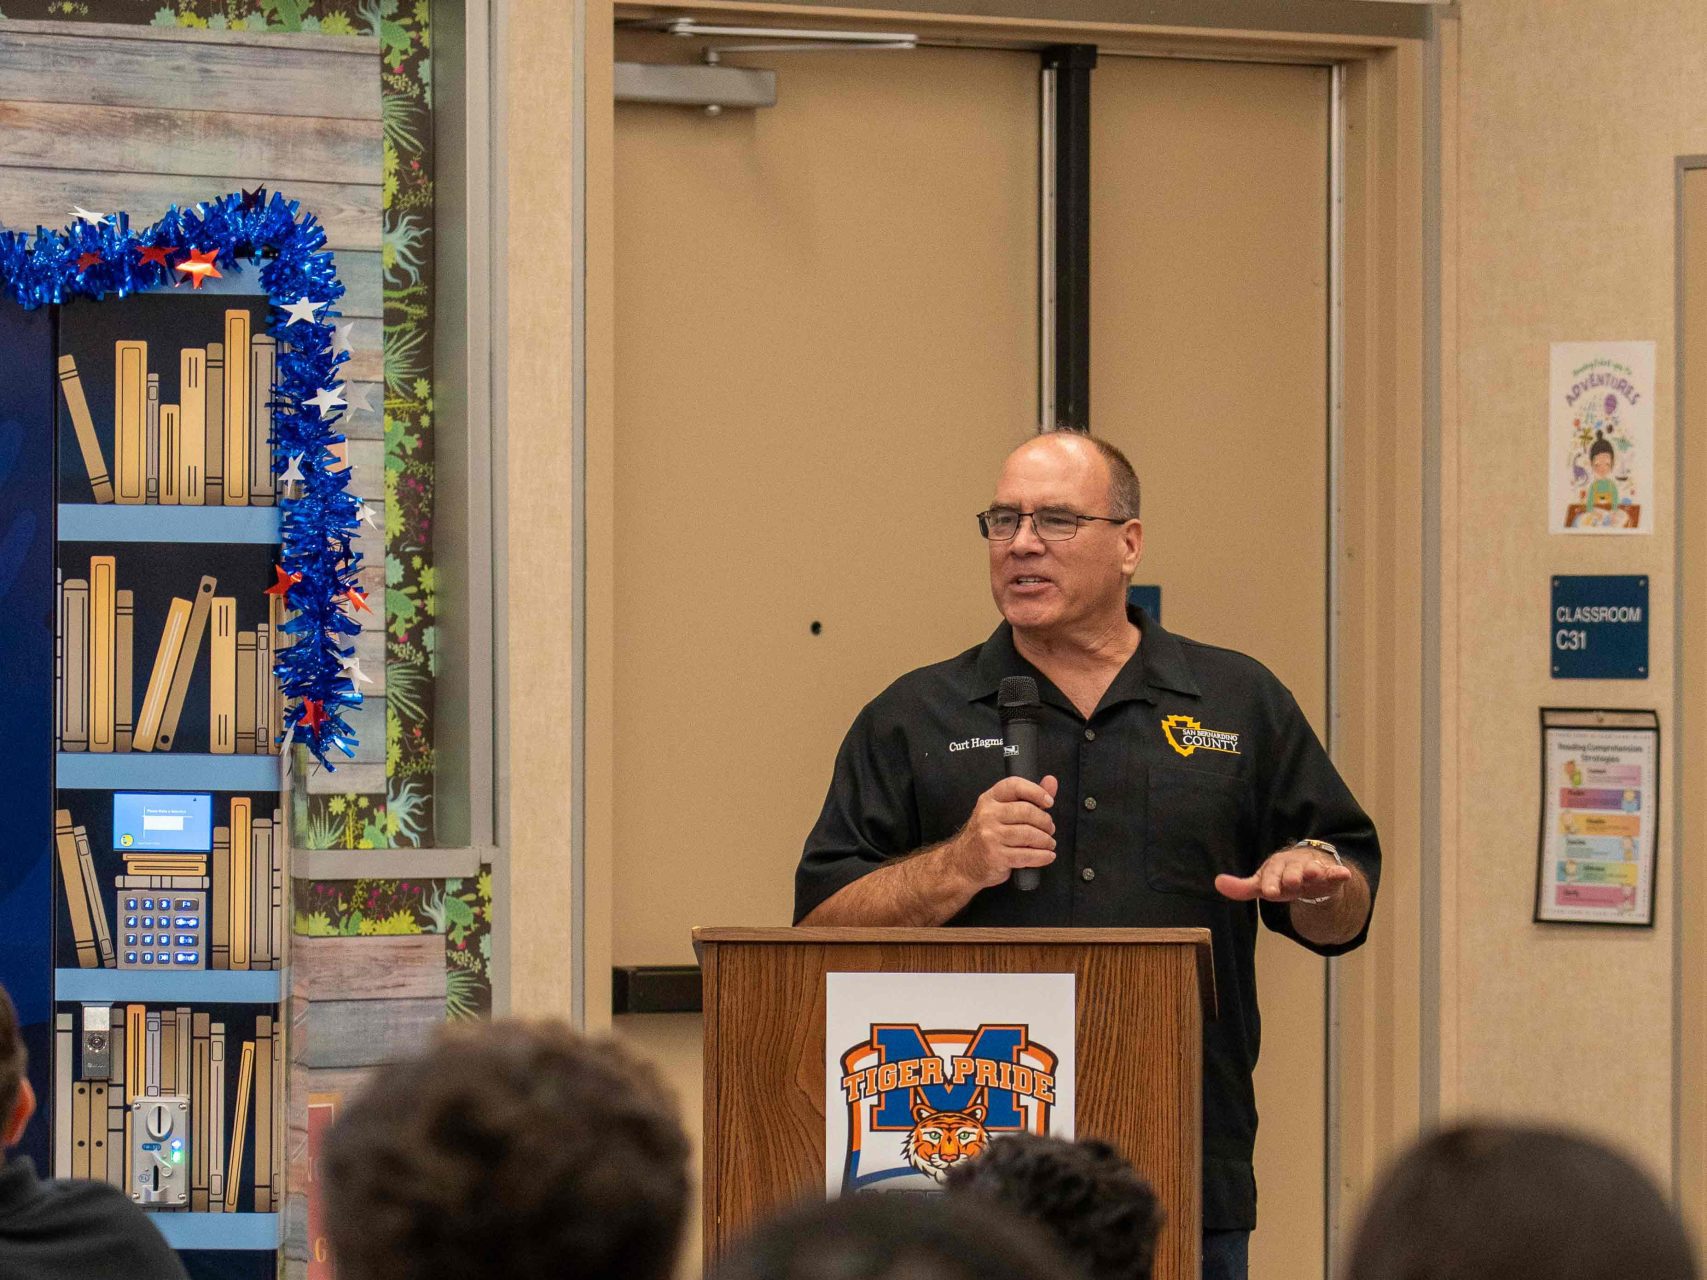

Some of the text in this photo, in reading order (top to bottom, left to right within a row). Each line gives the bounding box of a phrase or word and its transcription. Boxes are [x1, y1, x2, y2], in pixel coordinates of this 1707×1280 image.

[1565, 372, 1641, 408] ADVENTURES
[1556, 606, 1642, 623] CLASSROOM
[1556, 629, 1587, 651] C31
[1182, 728, 1238, 742] SAN BERNARDINO
[1182, 735, 1238, 752] COUNTY
[949, 737, 1004, 752] Curt Hagma
[842, 1057, 1056, 1104] TIGER PRIDE
